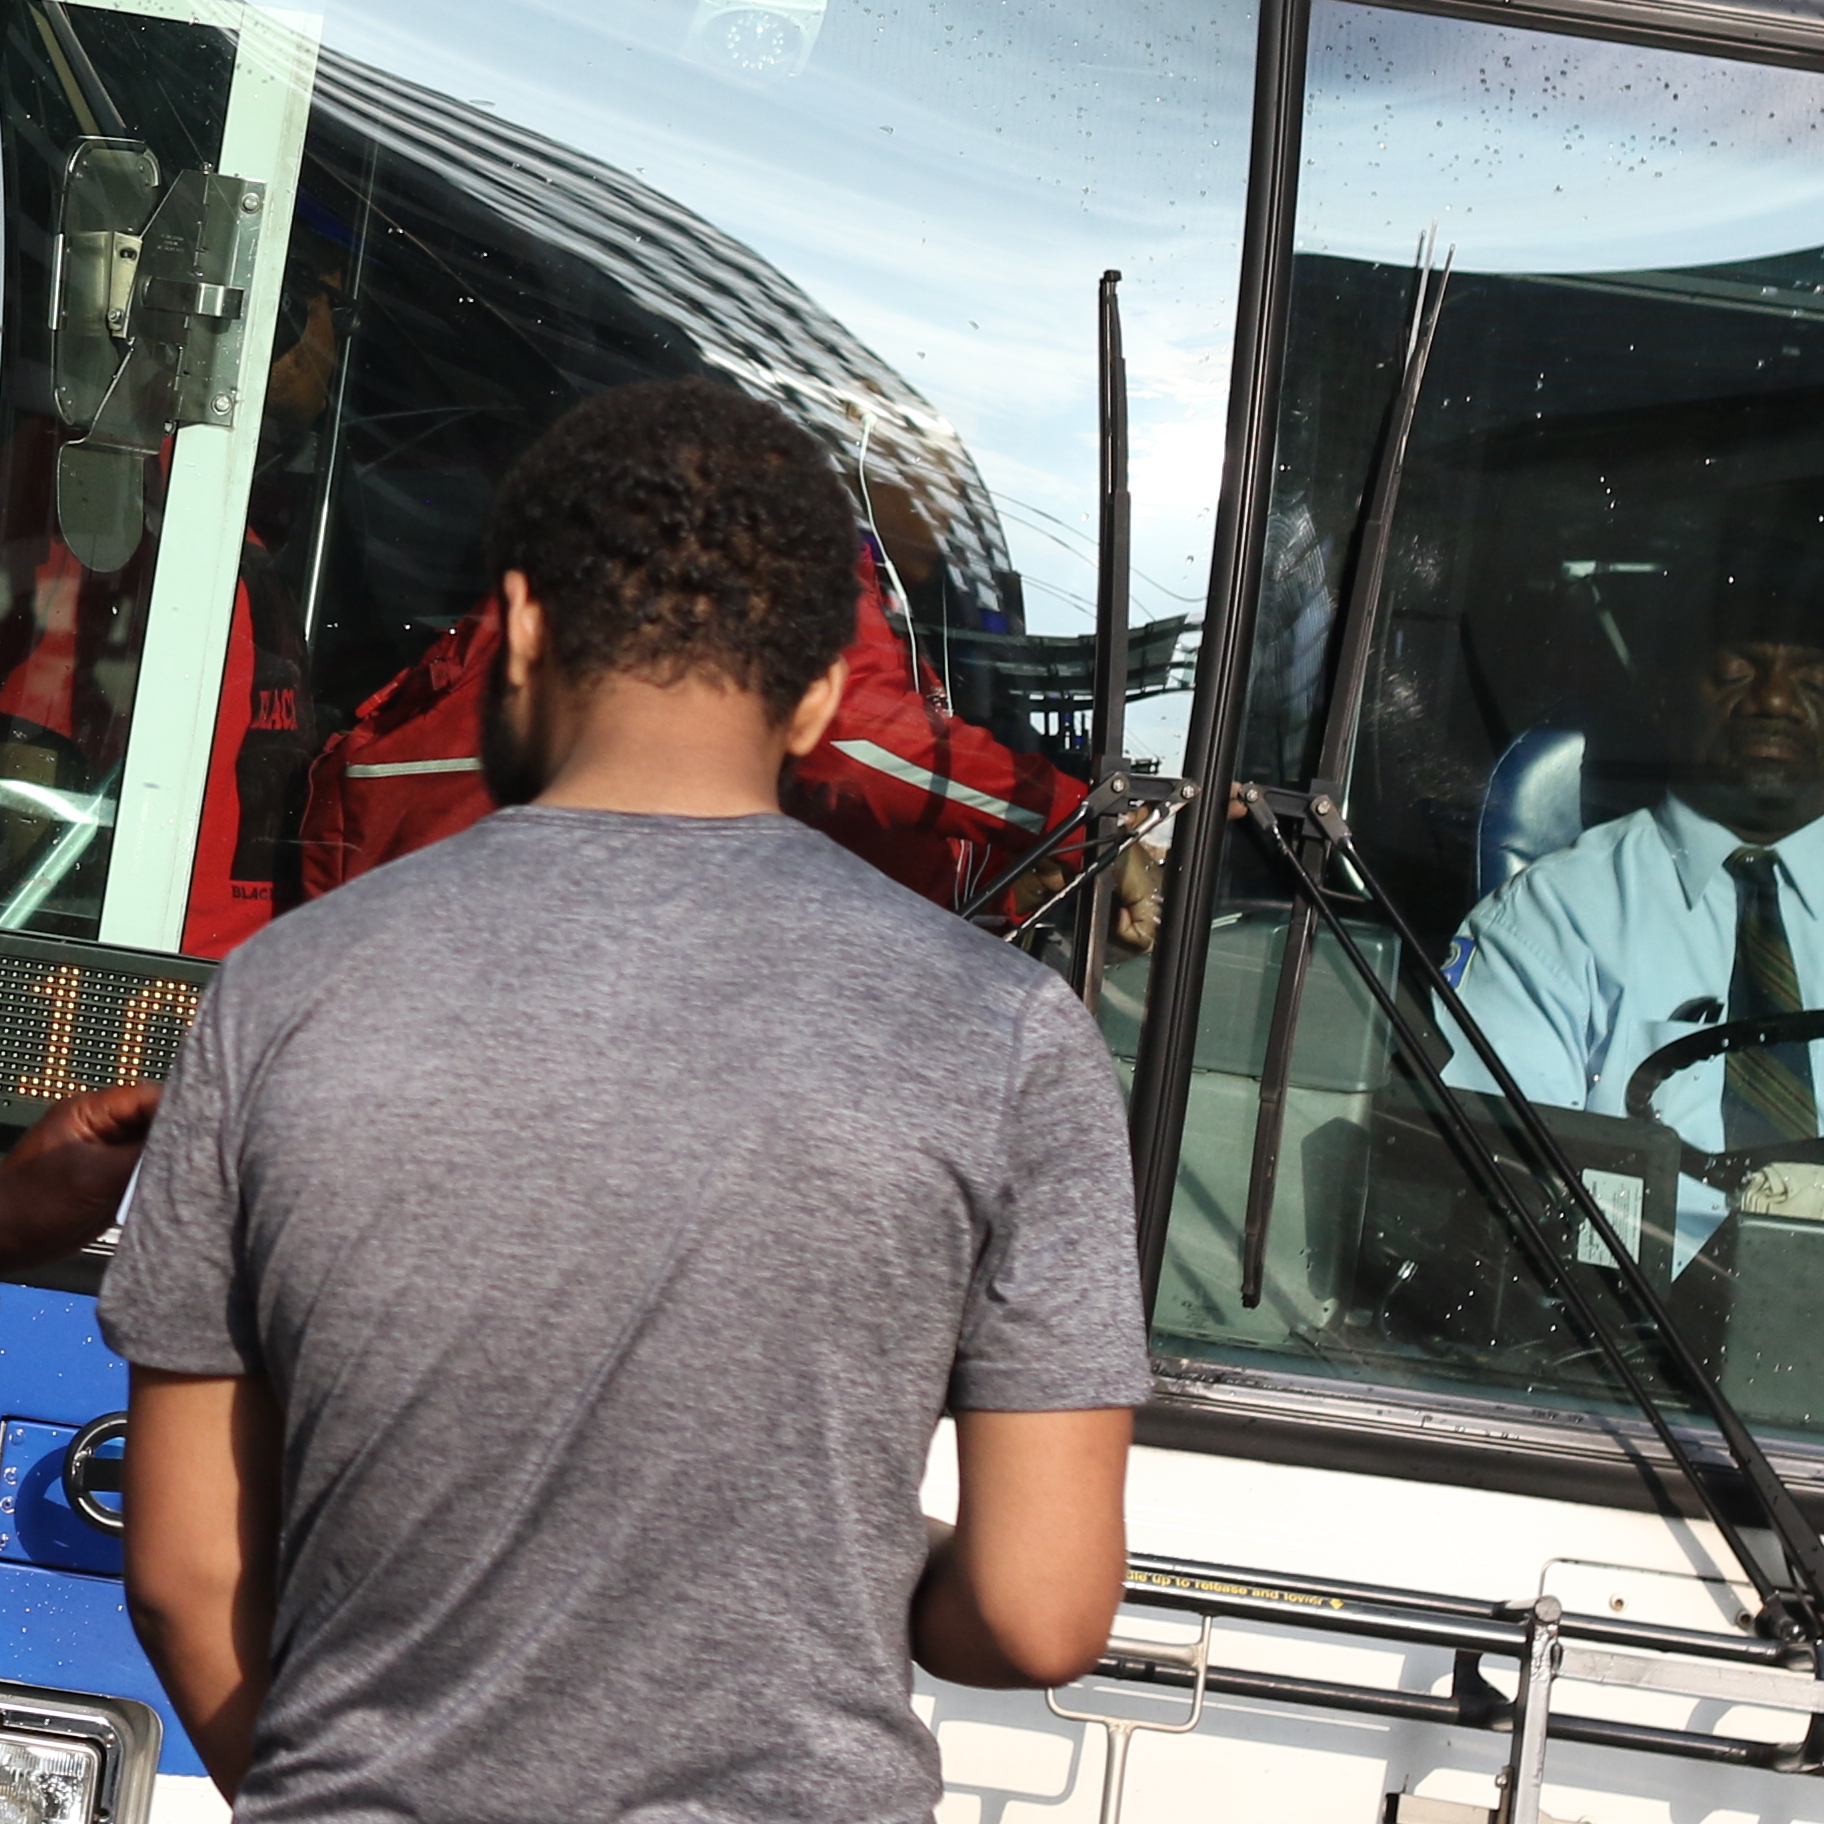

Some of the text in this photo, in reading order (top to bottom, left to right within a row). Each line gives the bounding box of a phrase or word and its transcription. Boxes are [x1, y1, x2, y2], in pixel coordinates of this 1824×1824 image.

[1176, 1577, 1191, 1589] to
[1195, 1579, 1248, 1596] release
[1252, 1587, 1280, 1601] and
